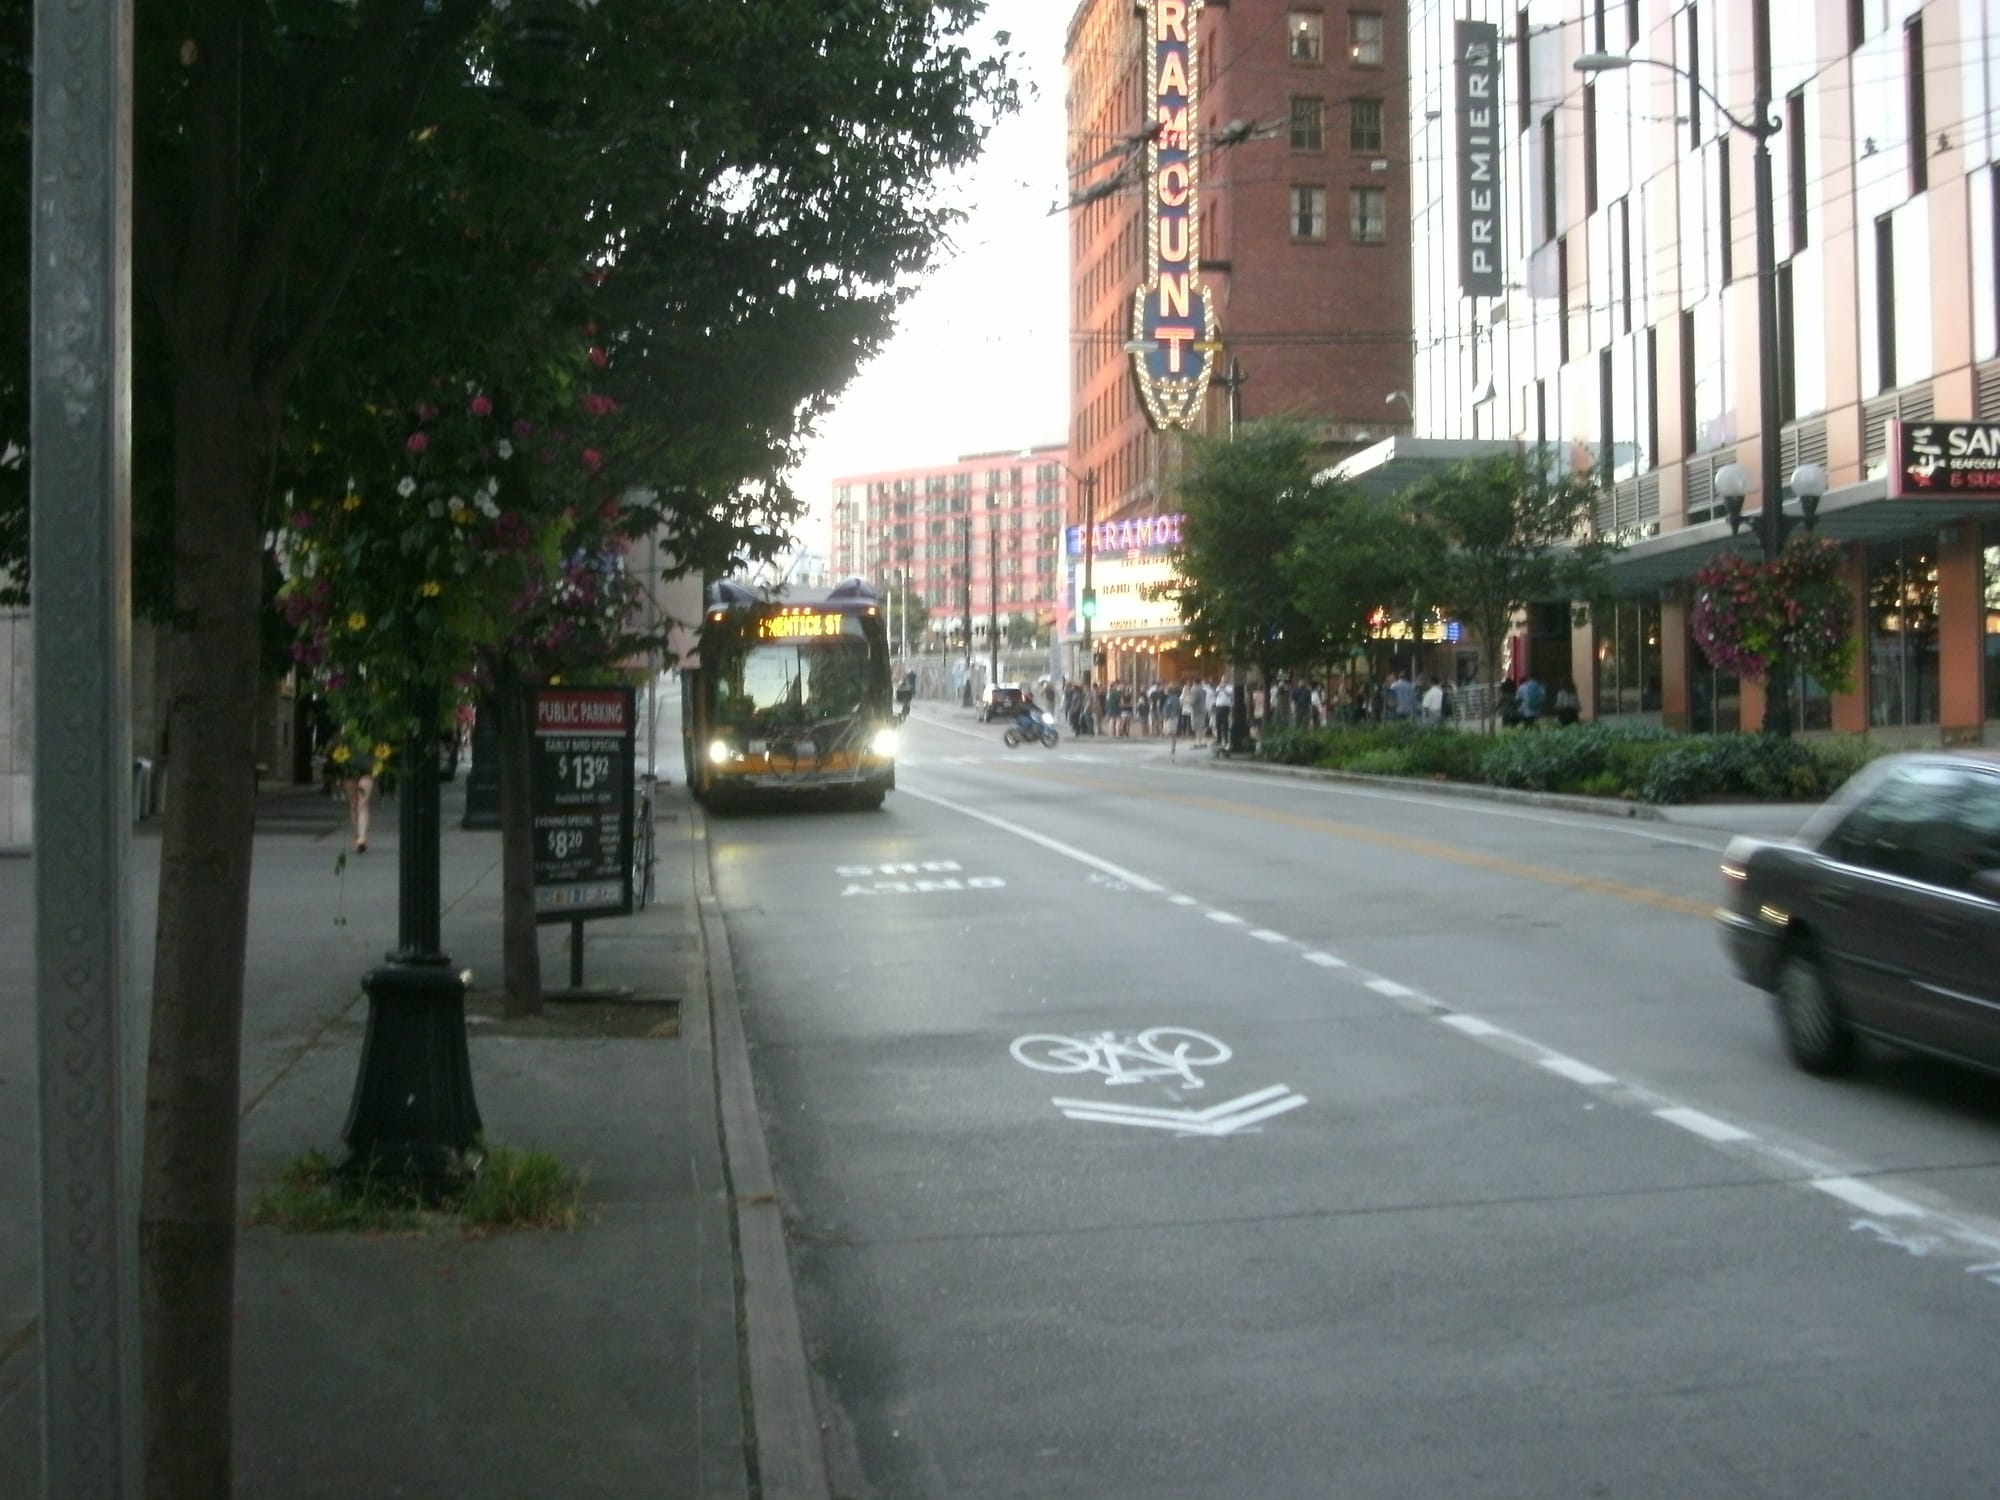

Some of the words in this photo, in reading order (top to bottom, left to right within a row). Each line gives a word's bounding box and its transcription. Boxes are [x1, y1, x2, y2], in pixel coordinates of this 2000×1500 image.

[1950, 458, 1996, 470] SEAFOOD
[825, 614, 842, 635] ST
[538, 701, 579, 722] PUBLIC
[580, 702, 623, 724] PARKING
[545, 738, 570, 752] EARLY
[572, 738, 590, 752] BIRD
[591, 738, 620, 752] SPECIAL
[535, 815, 566, 828] EVENING
[567, 815, 593, 827] SPECIAL
